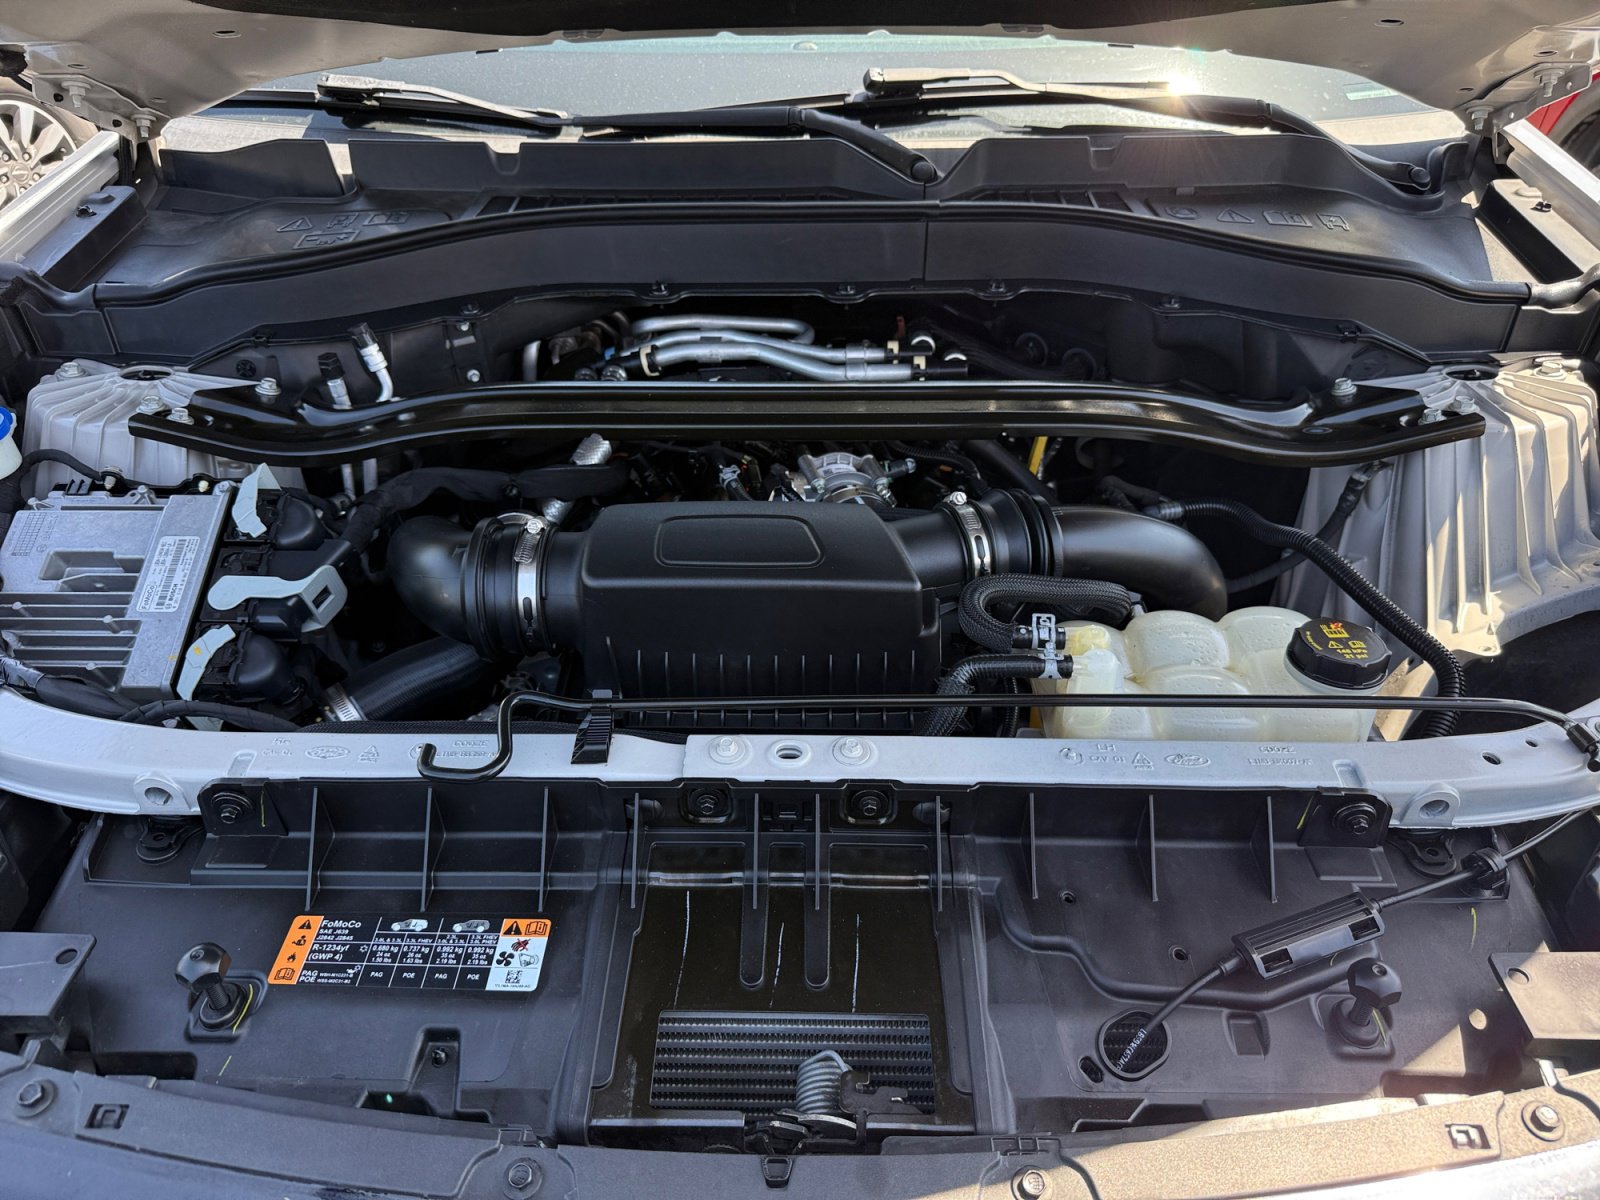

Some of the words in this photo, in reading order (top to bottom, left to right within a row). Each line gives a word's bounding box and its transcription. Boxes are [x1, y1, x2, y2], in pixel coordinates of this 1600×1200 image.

[168, 583, 179, 602] BOSCH
[141, 585, 155, 610] FoMoCo
[321, 920, 362, 929] FoMoCo
[312, 944, 350, 952] R-1234yf
[390, 945, 399, 953] kg
[421, 946, 430, 954] kg
[454, 946, 463, 954] kg
[485, 947, 494, 955] kg
[308, 953, 334, 961] (GWP
[334, 953, 343, 961] 4)
